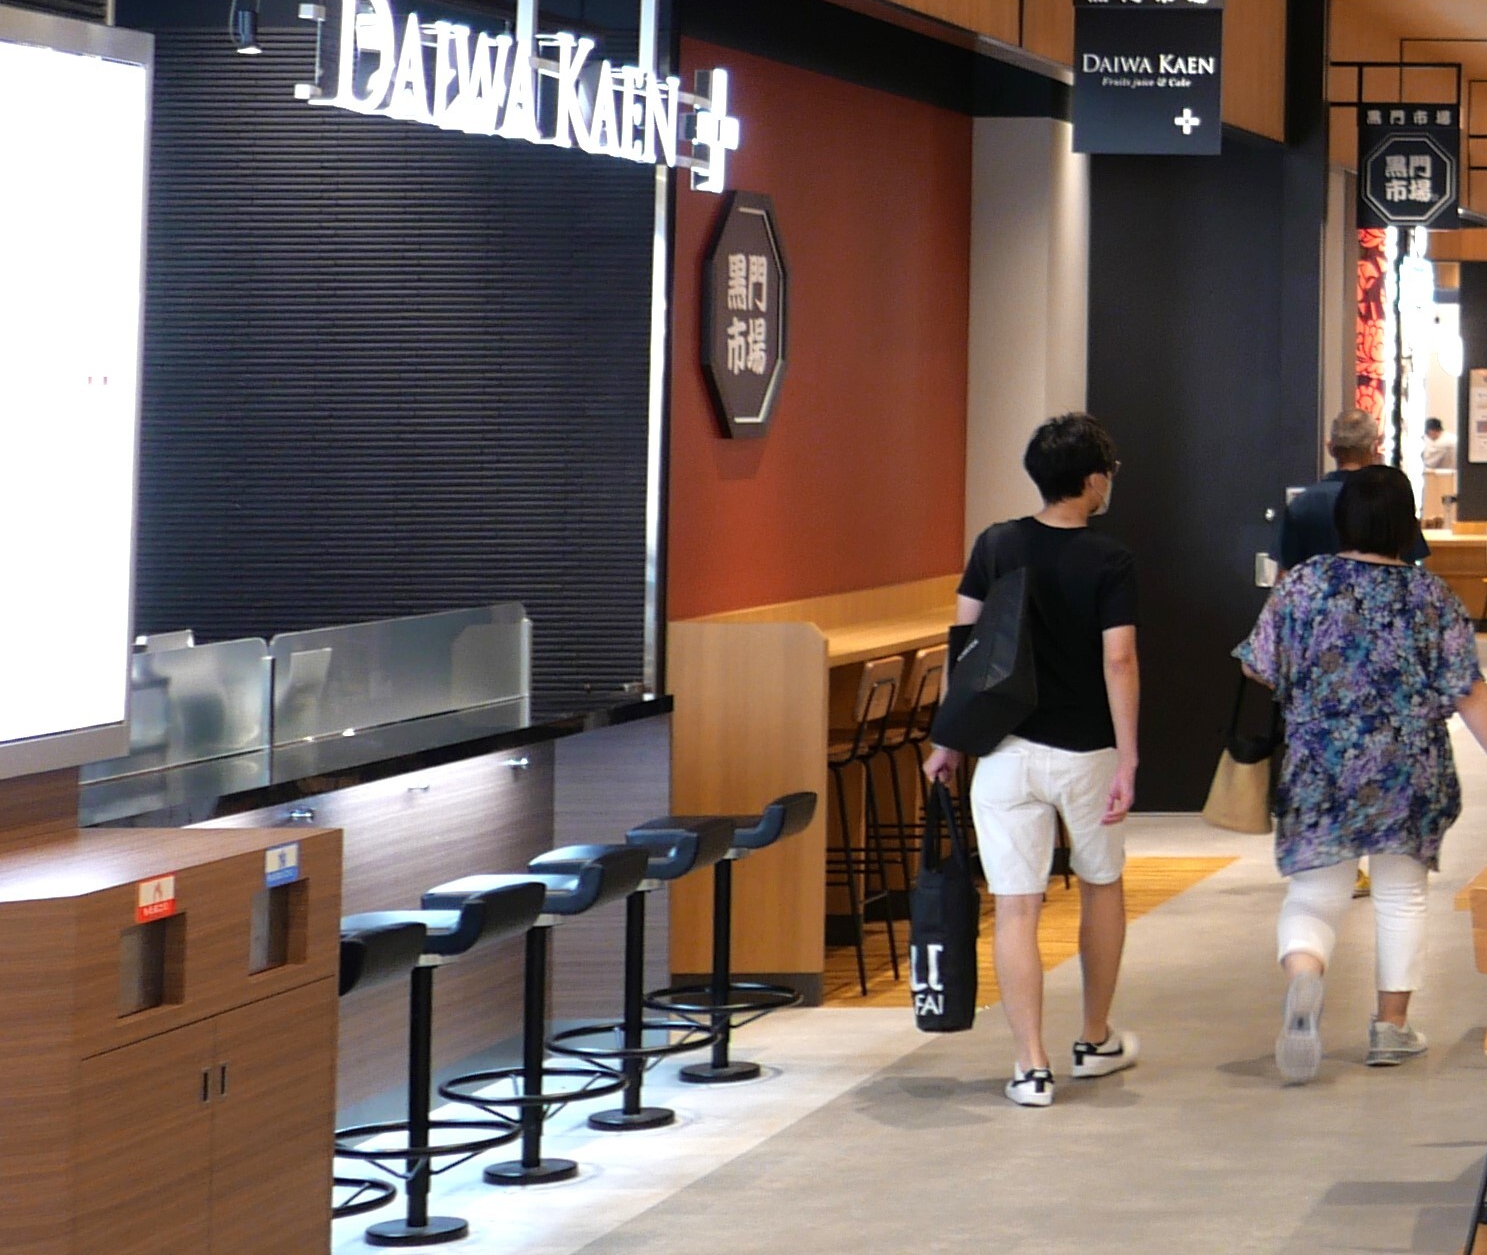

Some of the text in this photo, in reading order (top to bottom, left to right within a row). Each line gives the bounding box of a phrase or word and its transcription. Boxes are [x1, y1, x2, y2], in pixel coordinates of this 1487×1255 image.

[1082, 53, 1215, 75] DAIWA KAEN
[1366, 109, 1452, 126] 黒門市場
[1385, 154, 1432, 178] 黒門
[1385, 179, 1432, 203] 市場
[728, 253, 767, 312] 黒門
[728, 317, 767, 376] 市場
